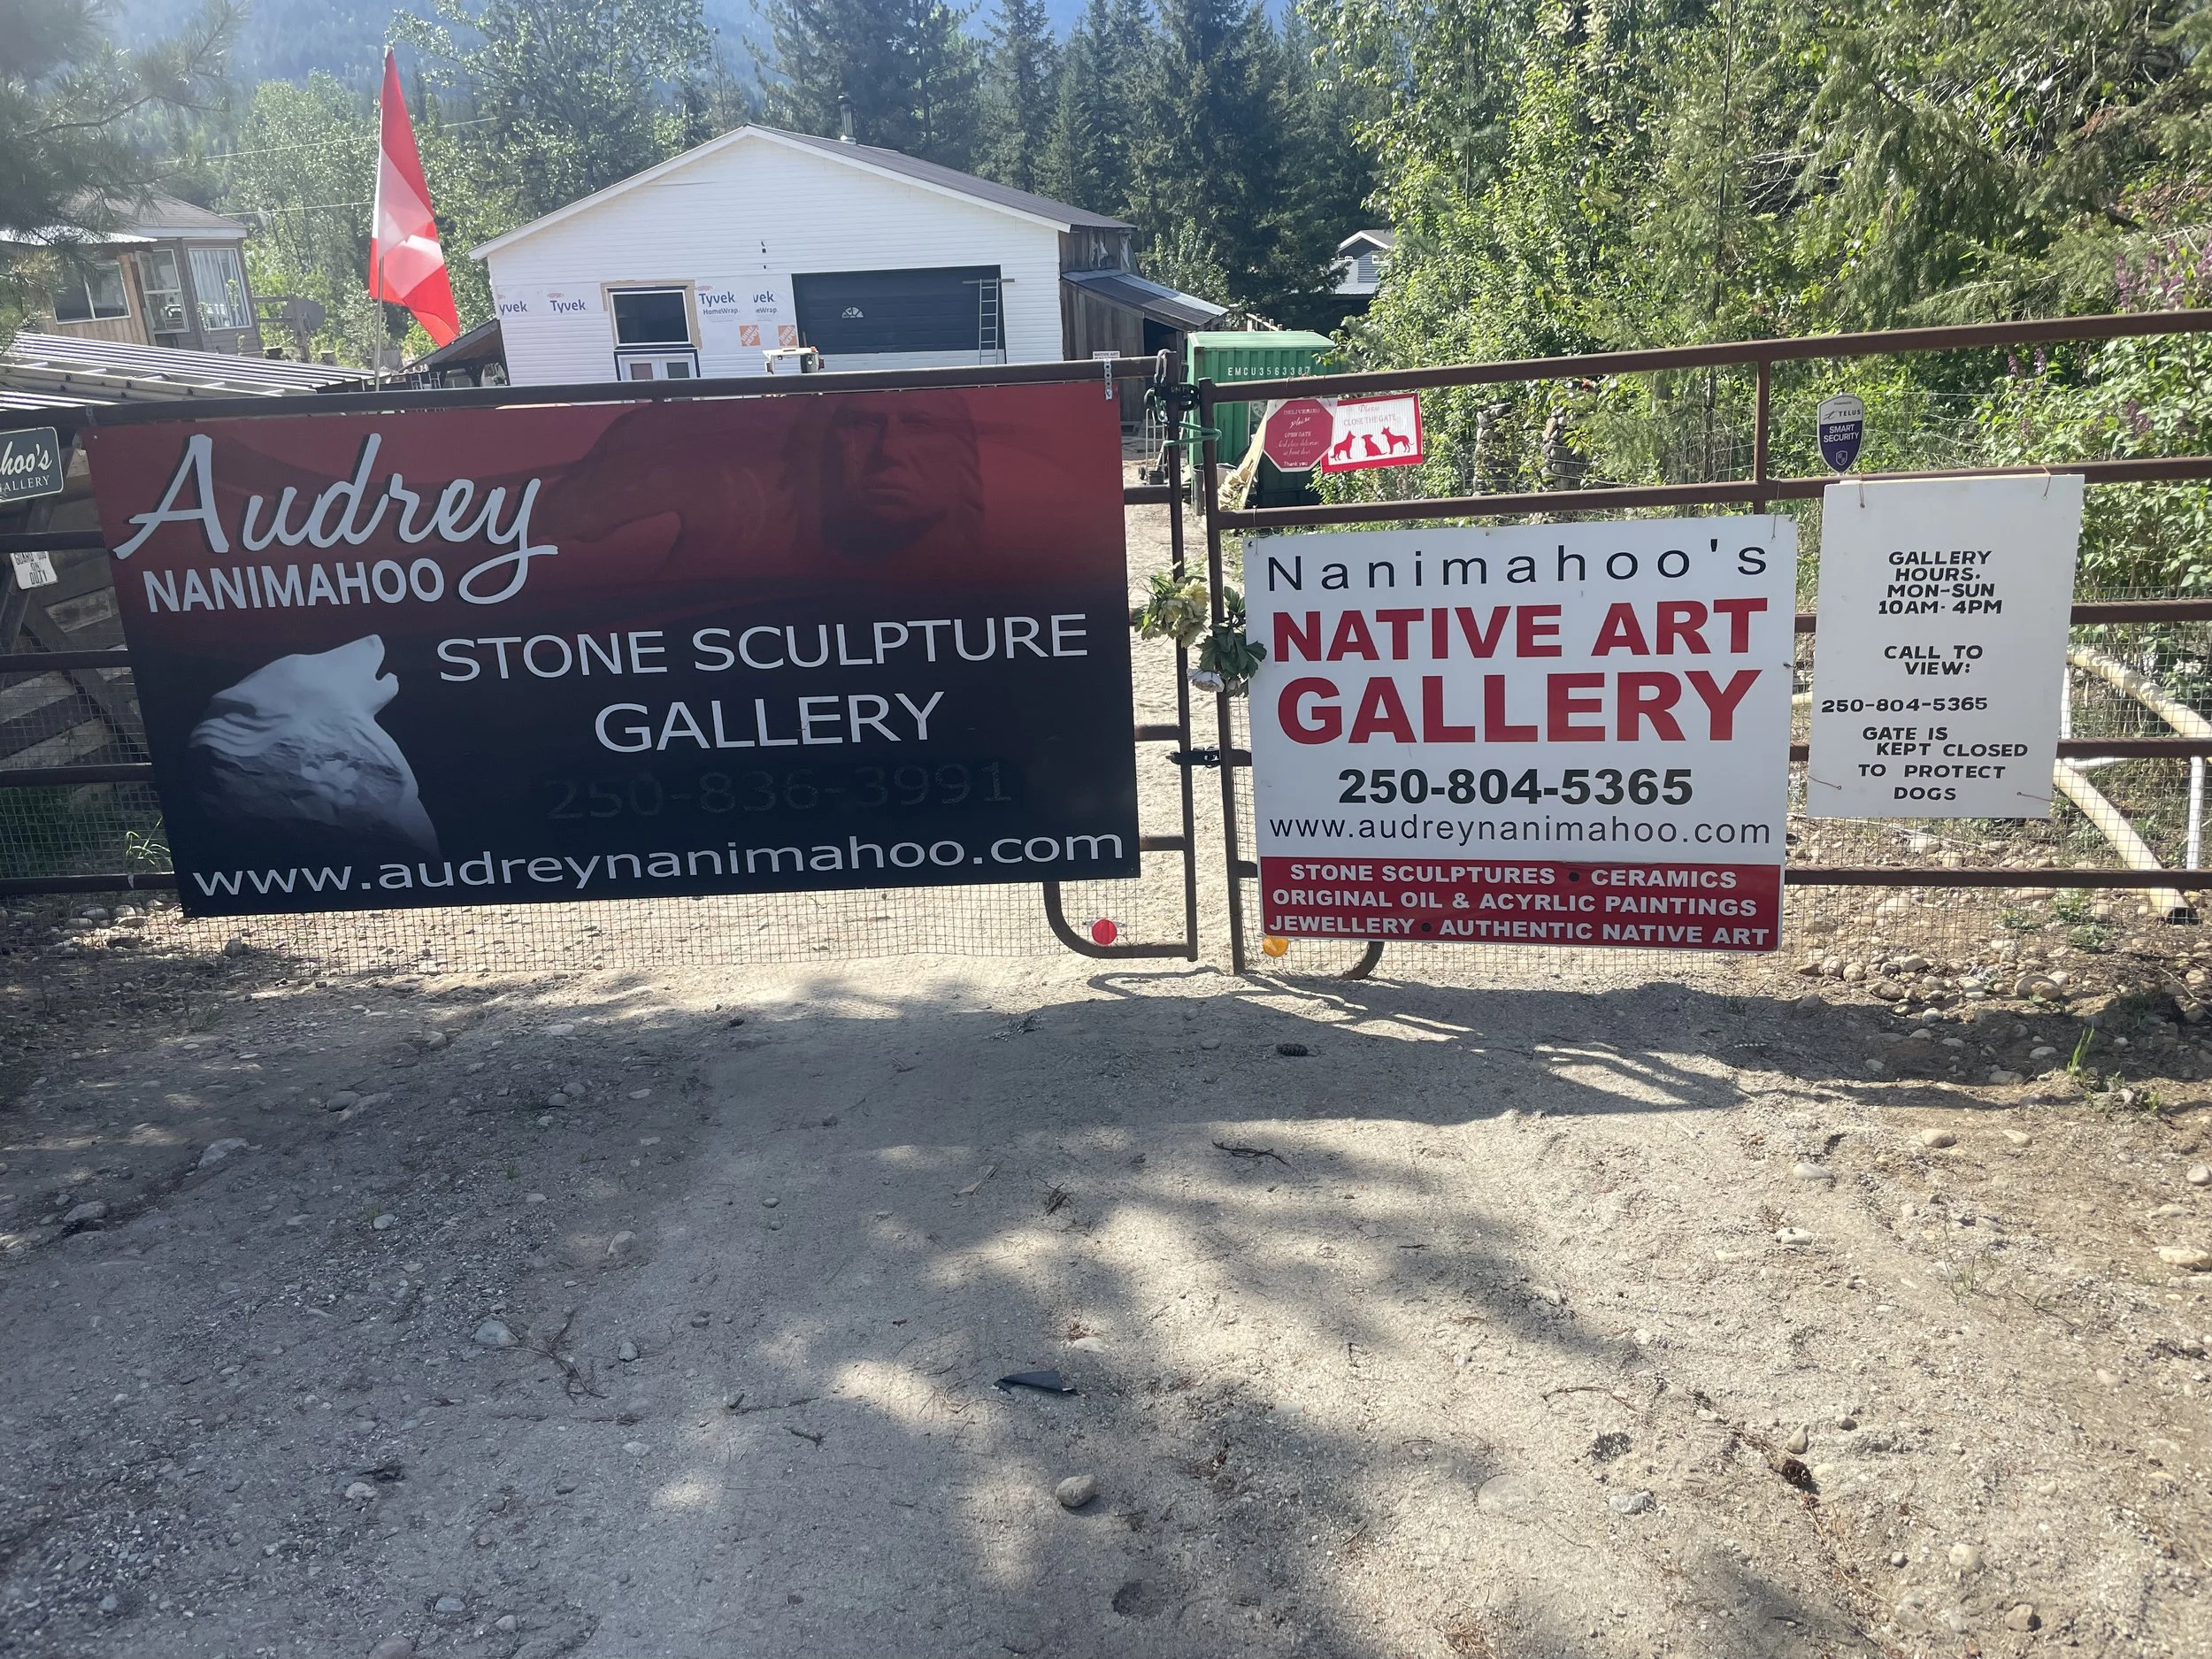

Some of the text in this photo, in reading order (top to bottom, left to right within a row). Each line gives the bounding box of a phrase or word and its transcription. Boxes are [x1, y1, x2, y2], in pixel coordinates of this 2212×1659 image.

[549, 299, 586, 313] Tyvek
[698, 291, 735, 307] Tyvek
[1839, 409, 1862, 418] TELUS
[1829, 424, 1855, 434] SMART
[1823, 432, 1860, 443] SECURITY
[112, 433, 558, 604] Audrey
[1888, 550, 1993, 565] GALLERY
[30, 562, 41, 572] ON
[1269, 539, 1767, 592] Nanimahoo's
[29, 570, 48, 585] DUTY
[142, 557, 445, 613] NANIMAHOO
[1886, 583, 1995, 598] MON-SUN
[1952, 599, 2003, 614] 4PM
[1273, 597, 1769, 663] NATIVE ART
[439, 613, 1088, 681] STONE SCULPTURE
[1884, 645, 1984, 660] CALL TO
[1904, 662, 1971, 675] VIEW:
[1277, 669, 1763, 746] GALLERY
[1821, 696, 1988, 713] 250-804-5365
[594, 691, 945, 753] GALLERY
[1863, 726, 1948, 741] GATE IS
[1876, 742, 2028, 757] KEPT CLOSED
[1858, 764, 2006, 779] TO PROTECT
[1338, 768, 1694, 806] 250-804-5365
[1893, 787, 1956, 801] DOGS
[1269, 814, 1770, 847] www.audreynanimahoo.com
[192, 830, 1123, 897] www.audreynanimahoo.com
[1289, 864, 1738, 890] STONE SCULPTURES CERAMICS
[1272, 888, 1758, 918] ORIGINAL OIL & ACYRLIC PAINTINGS
[1269, 915, 1770, 946] JEWELLERY AUTHENTIC NATIVE ART
